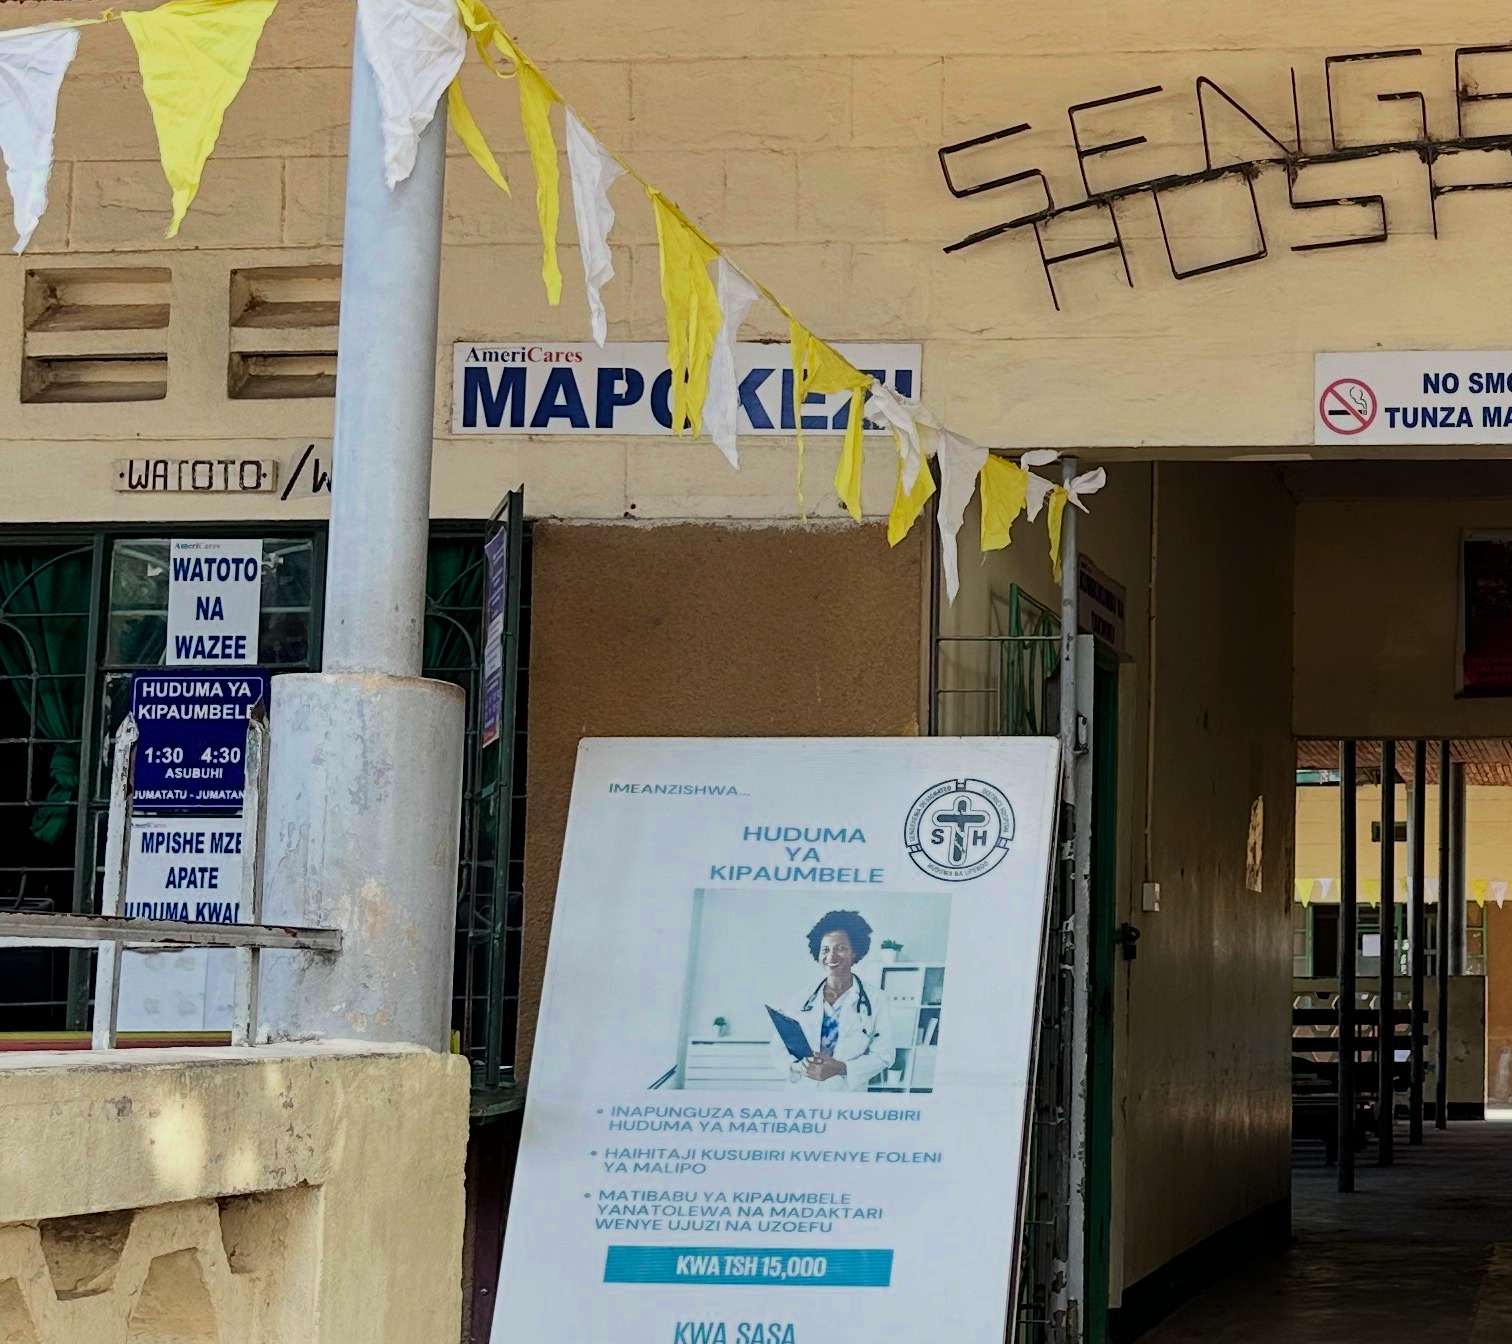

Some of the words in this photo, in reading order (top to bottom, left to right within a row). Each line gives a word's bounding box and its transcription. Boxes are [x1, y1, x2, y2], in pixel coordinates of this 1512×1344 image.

[464, 346, 584, 365] AmeriCares
[1422, 372, 1460, 395] NO
[1384, 406, 1474, 429] TUNZA
[127, 458, 263, 491] WATOTO
[172, 557, 259, 583] WATOTO
[195, 596, 225, 621] NA
[174, 635, 248, 660] WAZEE
[141, 681, 224, 698] HUDUMA
[227, 681, 252, 698] YA
[144, 747, 184, 764] 1:30
[200, 747, 241, 764] 4:30
[164, 767, 224, 779] ASUBUHI
[132, 789, 188, 800] JUMATATU
[195, 789, 246, 800] JUMATAN
[140, 831, 206, 854] MPISHE
[209, 832, 242, 854] MZE
[743, 826, 867, 844] HUDUMA
[931, 828, 945, 845] S
[972, 830, 988, 846] H
[785, 847, 821, 863] YA
[164, 866, 219, 889] APATE
[709, 865, 885, 884] KIPAUMBELE
[125, 902, 189, 922] UDUMA
[610, 1105, 735, 1120] INAPUNGUZA
[739, 1107, 778, 1121] SAA
[784, 1108, 832, 1121] TATU
[836, 1109, 922, 1122] KUSUBIRI
[608, 1119, 693, 1133] HUDUMA
[699, 1120, 722, 1133] YA
[728, 1121, 827, 1135] MATIBABU
[603, 1147, 697, 1161] HAIHITAJI
[701, 1148, 786, 1162] KUSUBIRI
[789, 1150, 871, 1163] KWENYE
[875, 1151, 943, 1164] FOLENI
[603, 1161, 628, 1174] YA
[632, 1161, 707, 1175] MALIPO
[597, 1189, 698, 1203] MATIBABU
[702, 1191, 726, 1204] YA
[731, 1191, 852, 1205] KIPAUMBELE
[596, 1204, 732, 1218] YANATOLEWA
[737, 1205, 765, 1218] NA
[769, 1206, 884, 1220] MADAKTARI
[594, 1218, 663, 1231] WENYE
[666, 1218, 721, 1232] UJUZI
[724, 1219, 753, 1232] NA
[757, 1220, 834, 1233] UZOEFU
[675, 1255, 721, 1276] KWA
[723, 1255, 759, 1276] TSH
[761, 1256, 828, 1280] 15,000
